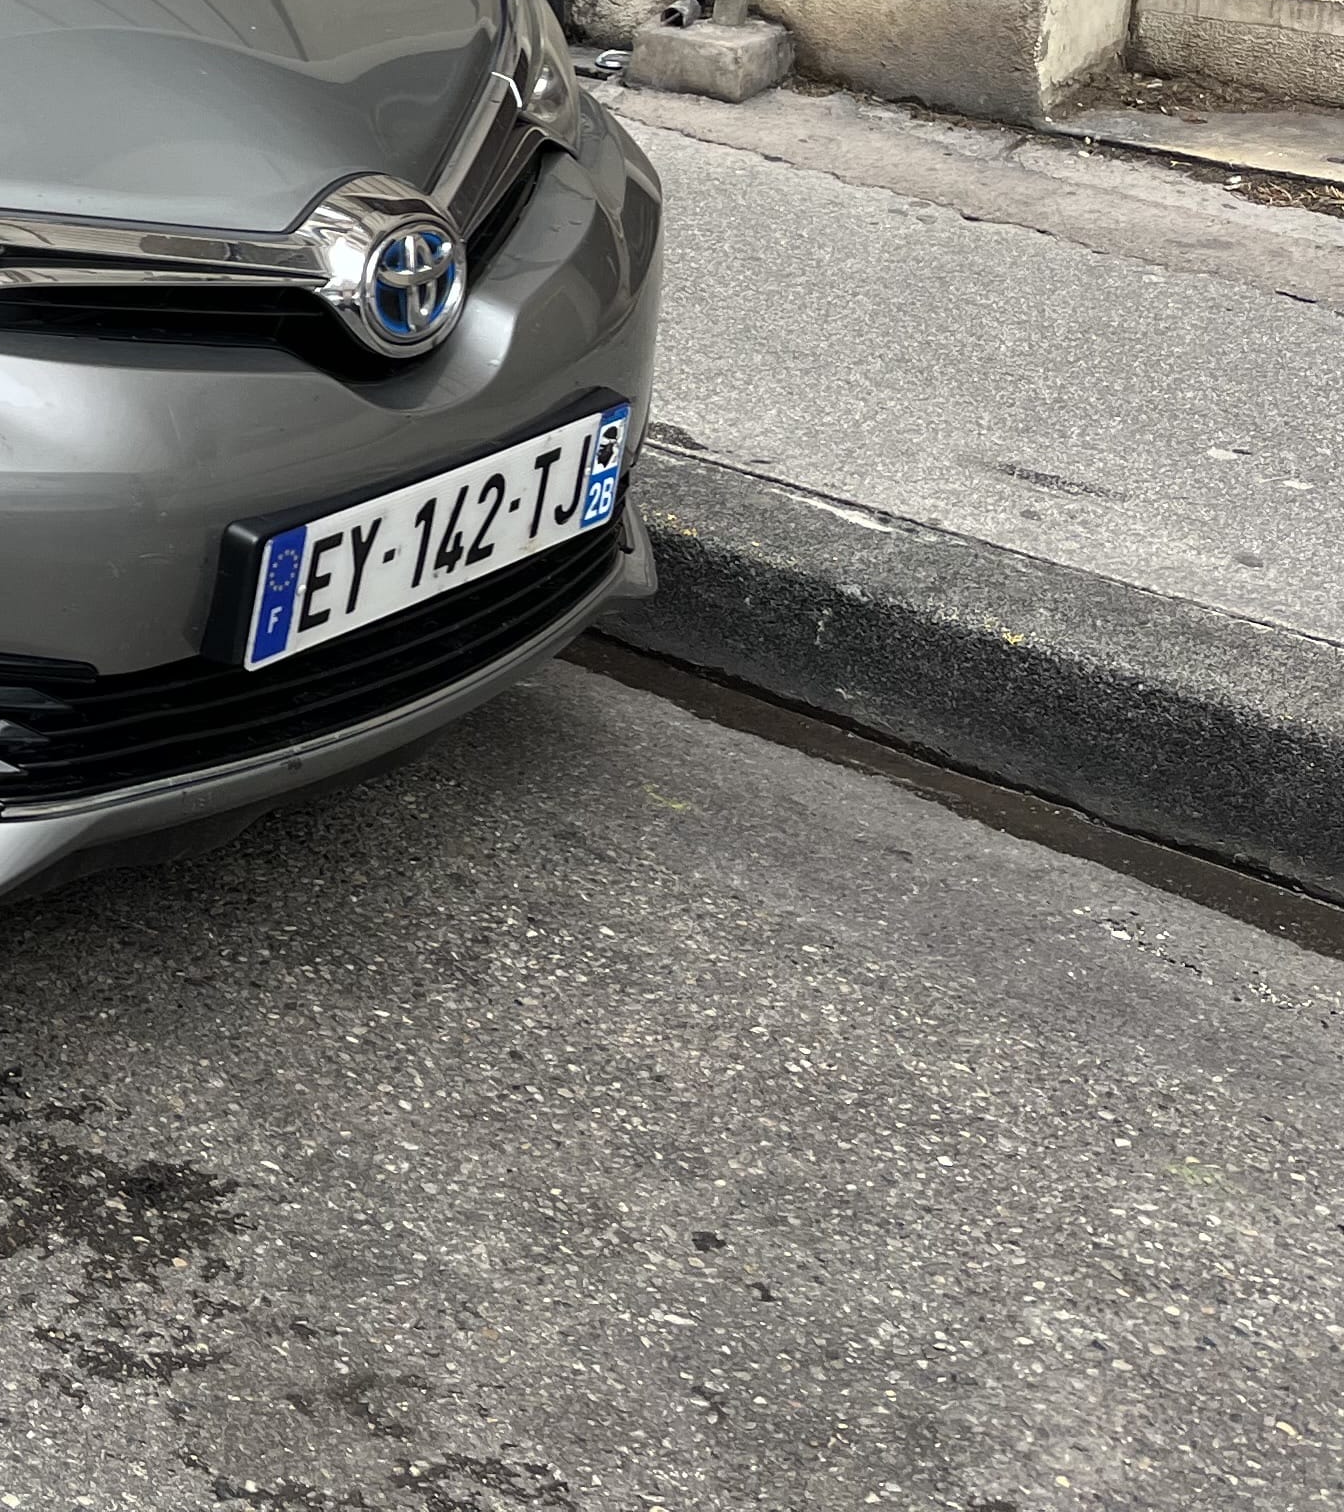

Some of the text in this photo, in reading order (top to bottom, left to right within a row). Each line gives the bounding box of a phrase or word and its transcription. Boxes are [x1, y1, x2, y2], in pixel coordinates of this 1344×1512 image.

[266, 433, 614, 635] F EY-142-TJ 2B
